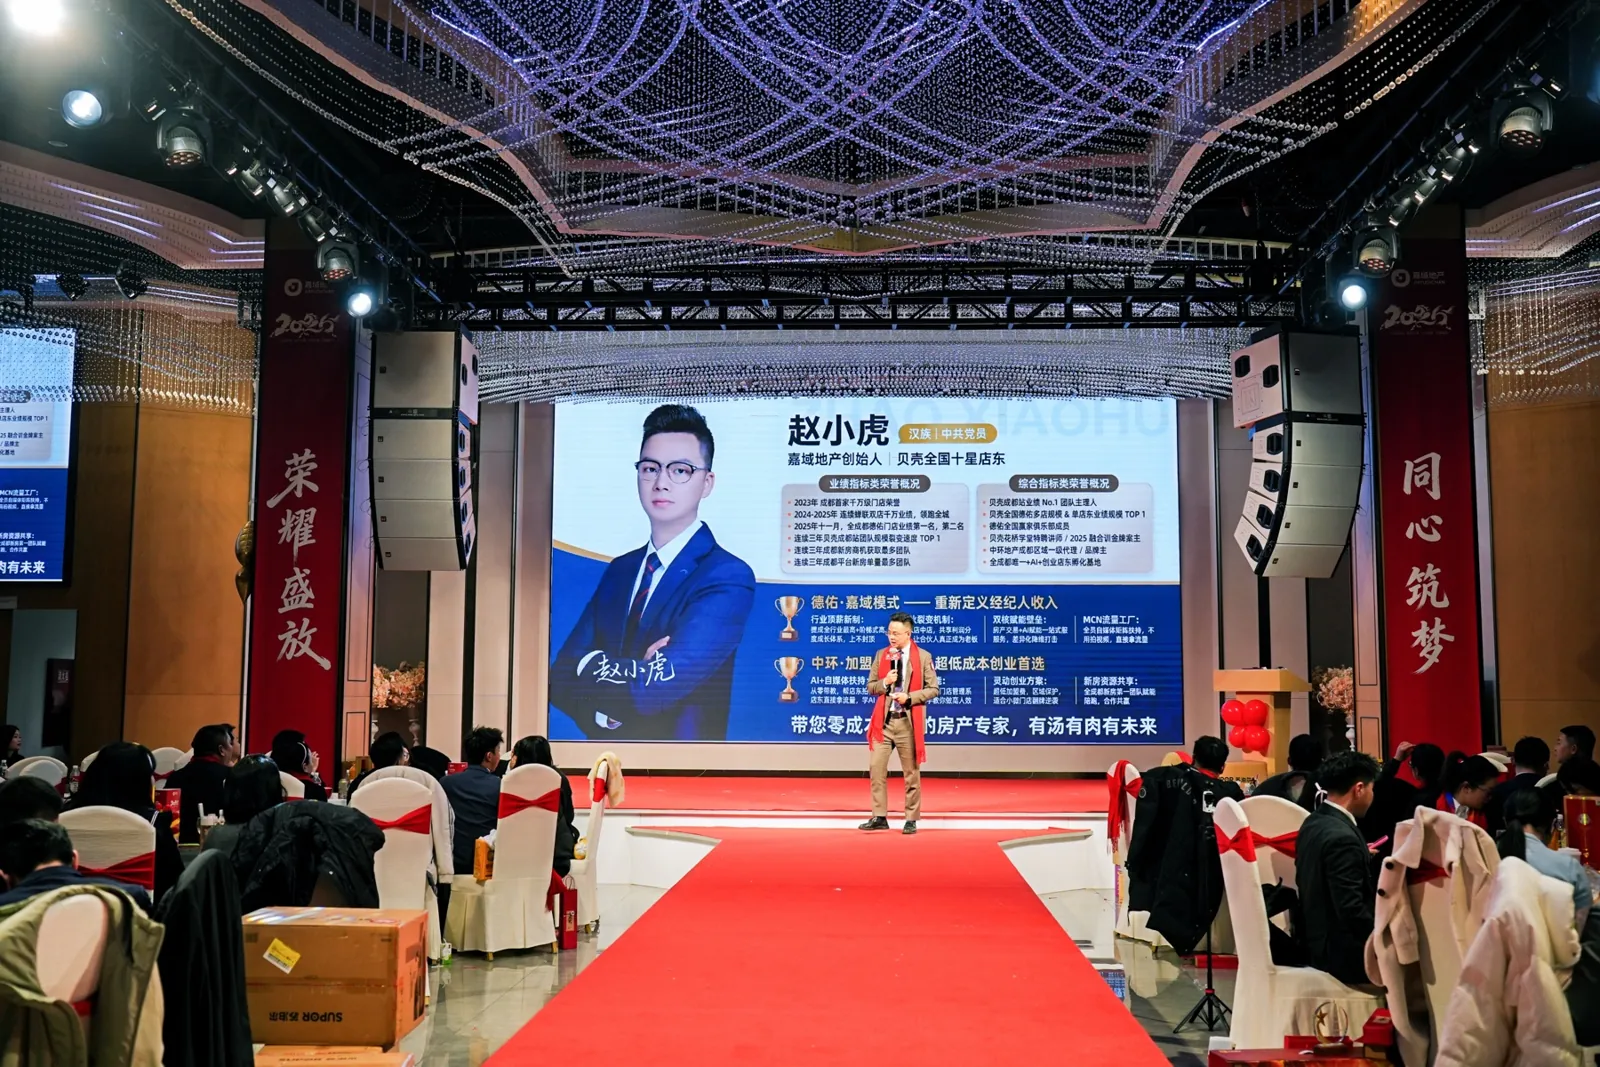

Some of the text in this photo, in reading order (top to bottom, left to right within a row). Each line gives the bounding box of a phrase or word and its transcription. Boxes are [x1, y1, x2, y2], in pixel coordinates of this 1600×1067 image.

[788, 414, 889, 446] 赵小虎
[908, 428, 987, 440] 汉族 中共党员
[788, 452, 1006, 466] 嘉域地产创始人 贝壳全国十星店东
[829, 478, 920, 490] 业绩指标类荣誉概况
[1018, 478, 1110, 489] 综合指标类荣誉概况
[794, 499, 818, 507] 2023年
[989, 498, 1097, 507] 贝壳成都站业绩 No.1 团队主理人
[794, 510, 837, 519] 2024-2025年
[1071, 510, 1124, 519] 单店东业绩规模
[989, 522, 1070, 531] 德佑全国赢家俱乐部成员
[920, 535, 935, 543] TOP
[1070, 535, 1087, 543] 2025
[989, 546, 1078, 555] 中环地产成都区域一级代理
[1085, 546, 1107, 555] 品牌主
[266, 448, 332, 671] 荣耀盛放
[1403, 452, 1455, 675] 同心筑梦
[811, 595, 899, 610] 德佑·嘉域模式
[935, 595, 1058, 610] 重新定义经纪人收入
[1083, 615, 1140, 624] MCN流量工厂：
[577, 650, 675, 686] 赵小虎
[935, 656, 1045, 671] 超低成本创业首选
[993, 676, 1047, 686] 灵动创业方案：
[1084, 677, 1138, 686] 新房资源共享：
[925, 716, 1158, 736] 的房产专家，有汤有肉有未来
[269, 1012, 343, 1022] SUPOR 苏泊尔
